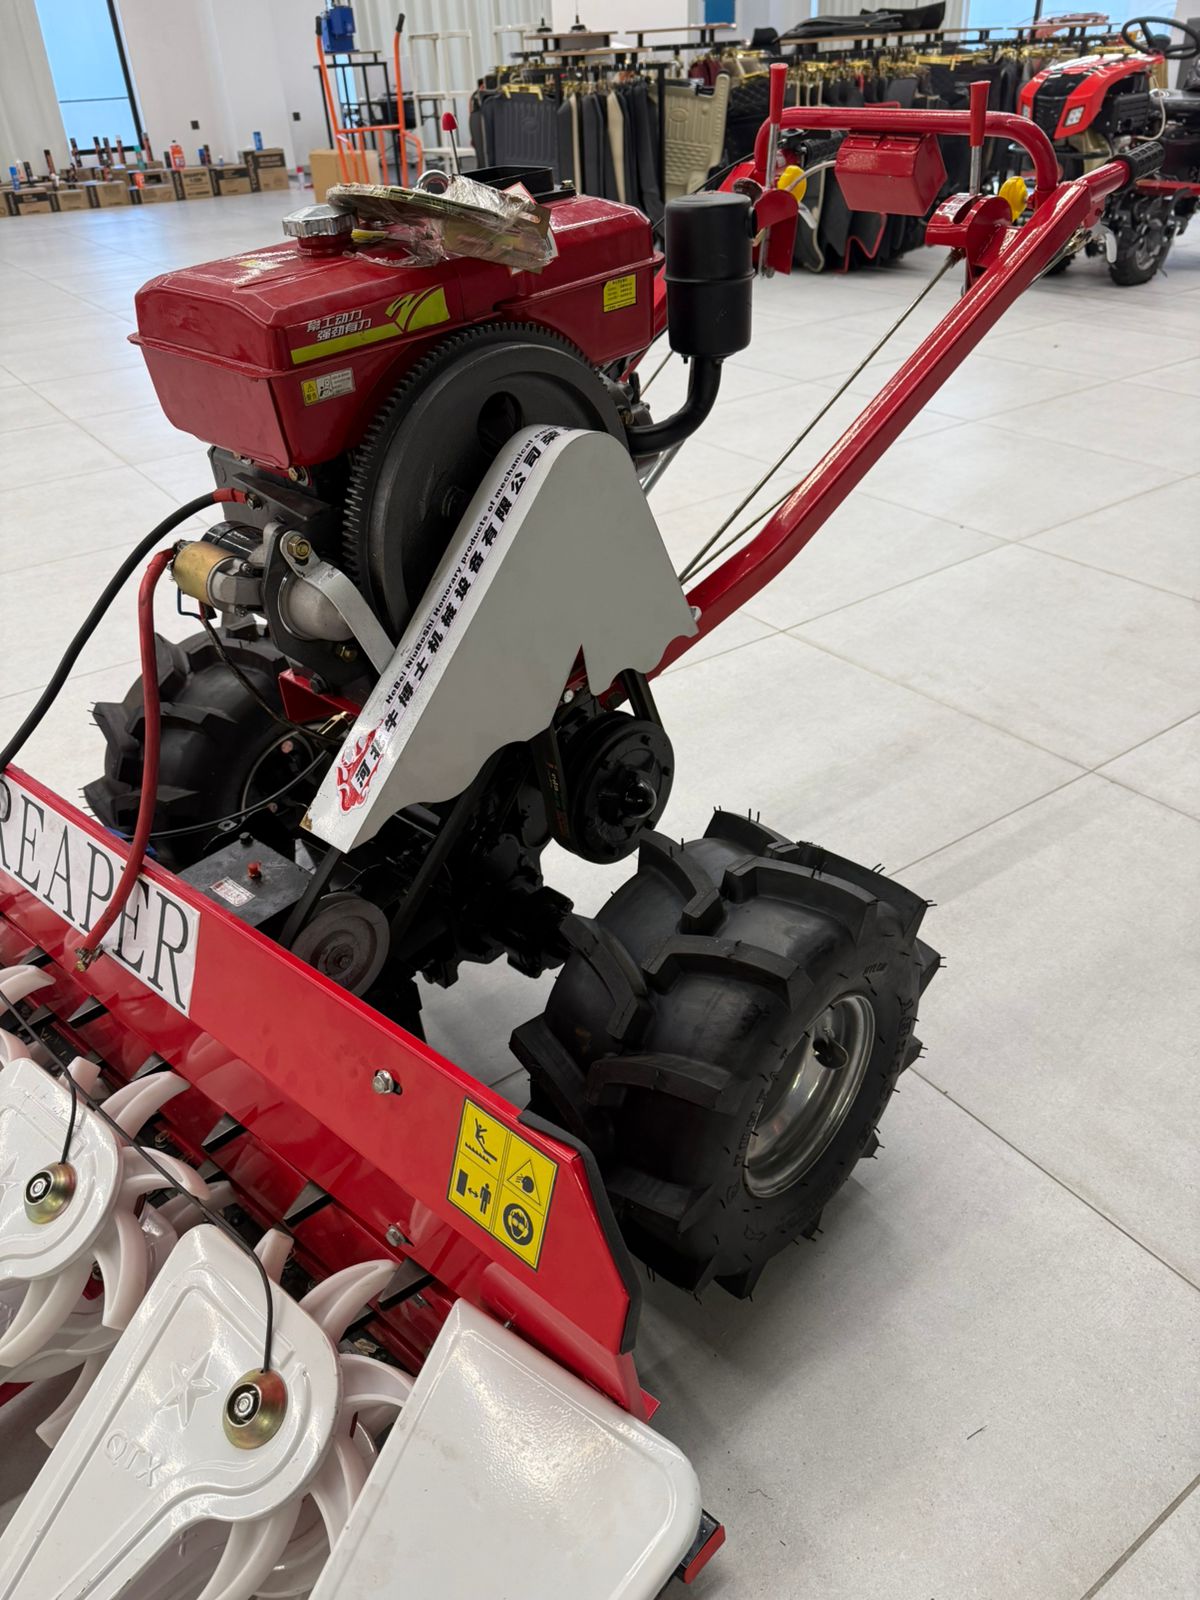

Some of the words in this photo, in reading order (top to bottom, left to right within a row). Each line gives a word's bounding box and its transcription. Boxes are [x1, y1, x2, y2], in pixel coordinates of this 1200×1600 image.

[316, 319, 371, 341] 强劲有力
[355, 426, 573, 788] 河北牛博士机械设备有限公司荣
[386, 671, 407, 704] HeBei
[405, 619, 434, 670] NiuBoShi
[433, 566, 462, 617] Honorary
[460, 515, 488, 564] products
[487, 500, 496, 512] of
[494, 440, 533, 498] mechanical
